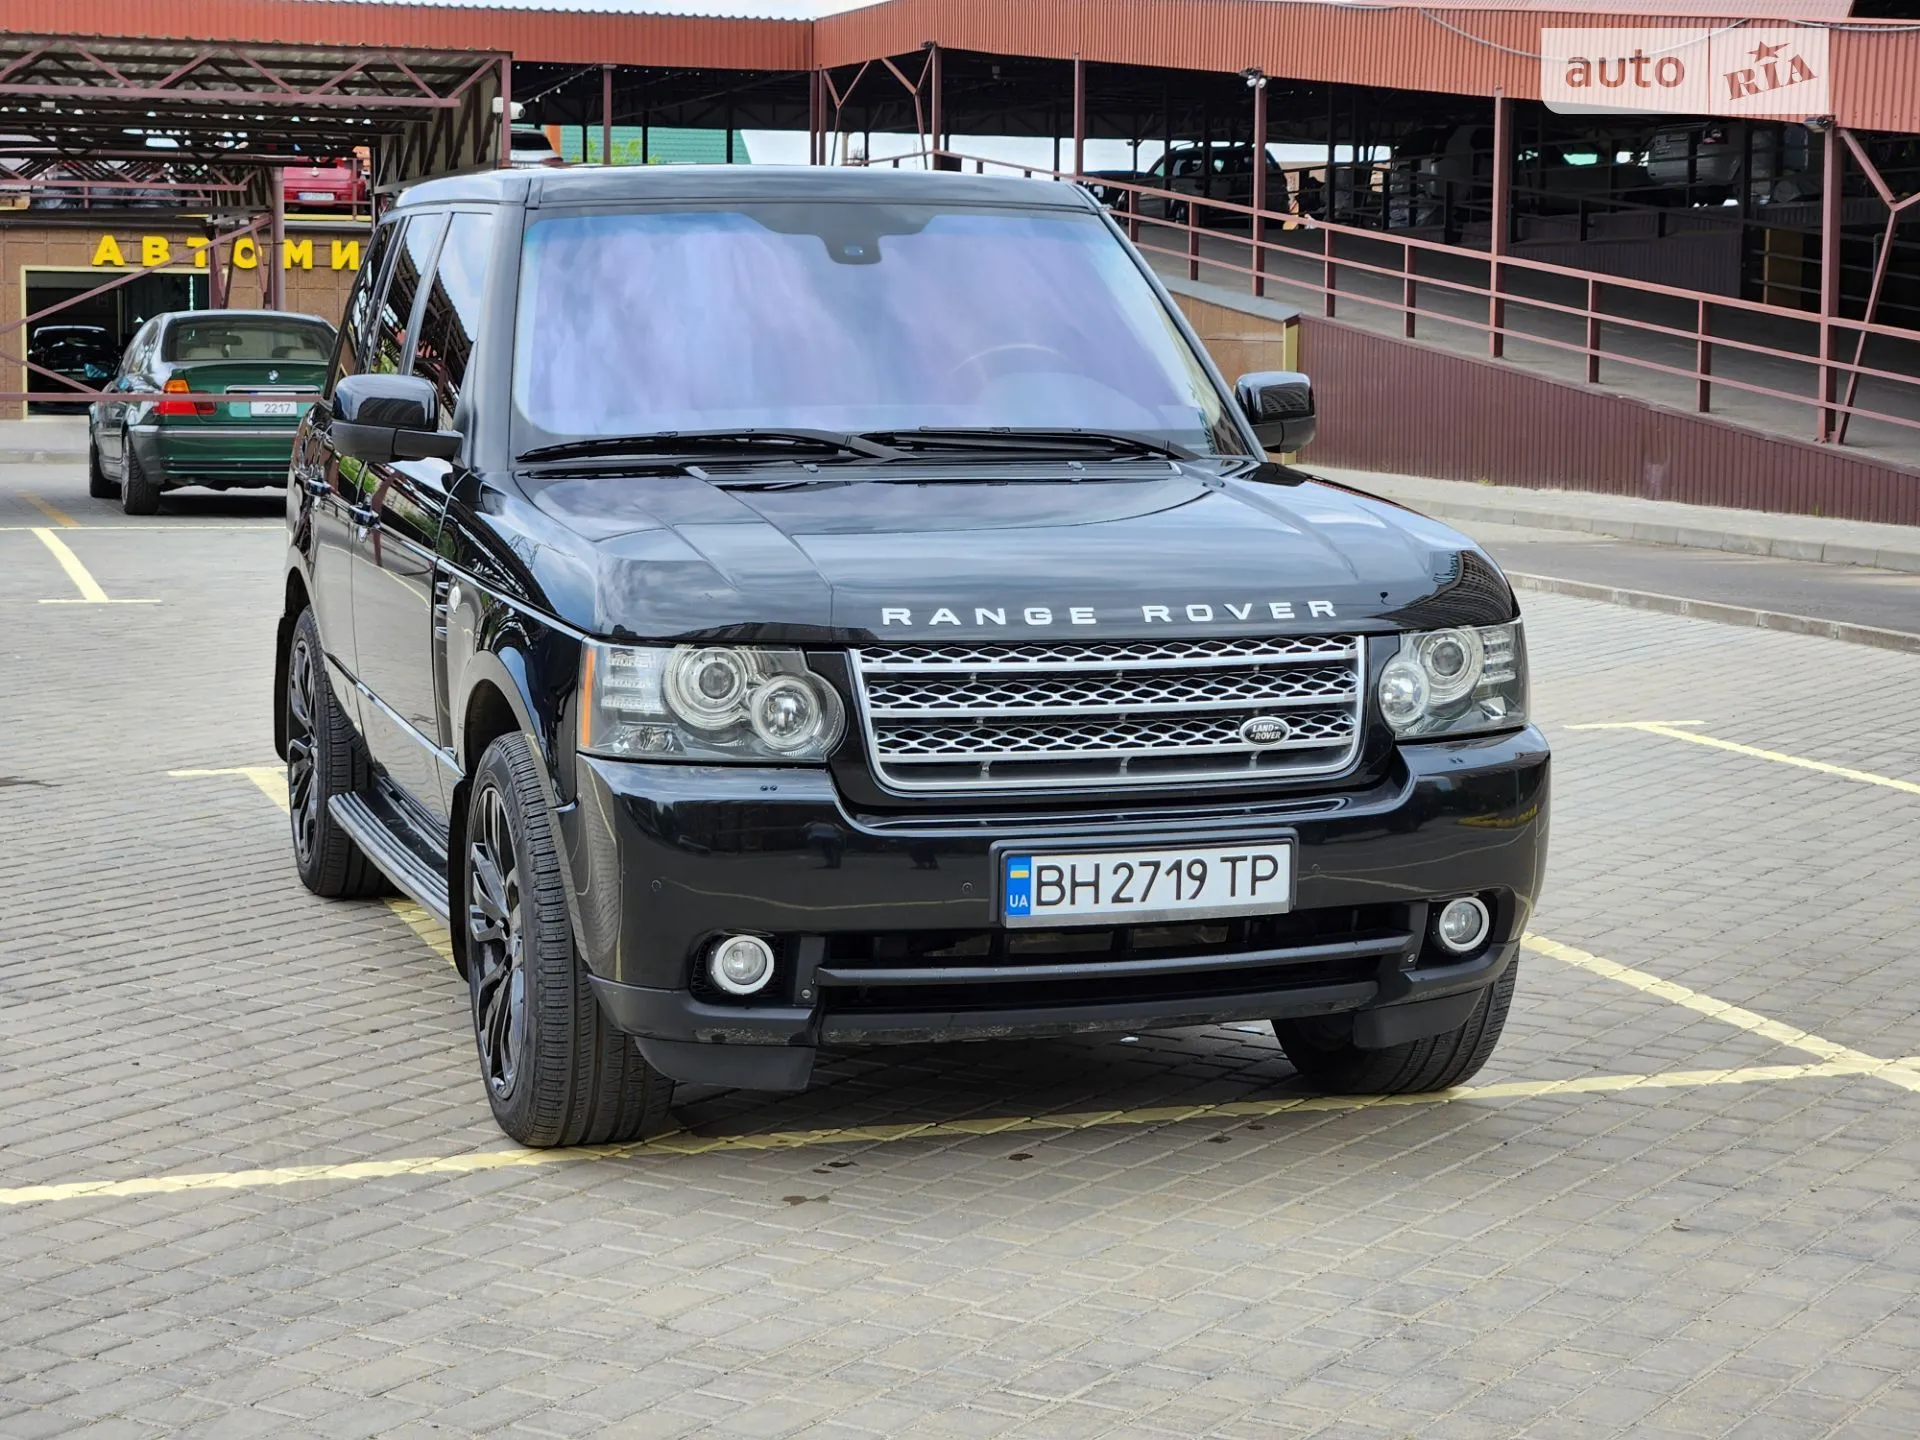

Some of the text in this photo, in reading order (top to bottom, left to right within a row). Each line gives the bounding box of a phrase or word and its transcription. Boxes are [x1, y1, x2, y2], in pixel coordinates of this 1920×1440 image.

[264, 403, 291, 414] 2217
[881, 600, 1337, 626] RANGE ROVER
[1252, 724, 1274, 733] LAND
[1254, 731, 1281, 740] ROVER
[1036, 854, 1279, 906] BH 2719 TP
[1009, 894, 1029, 908] UA
